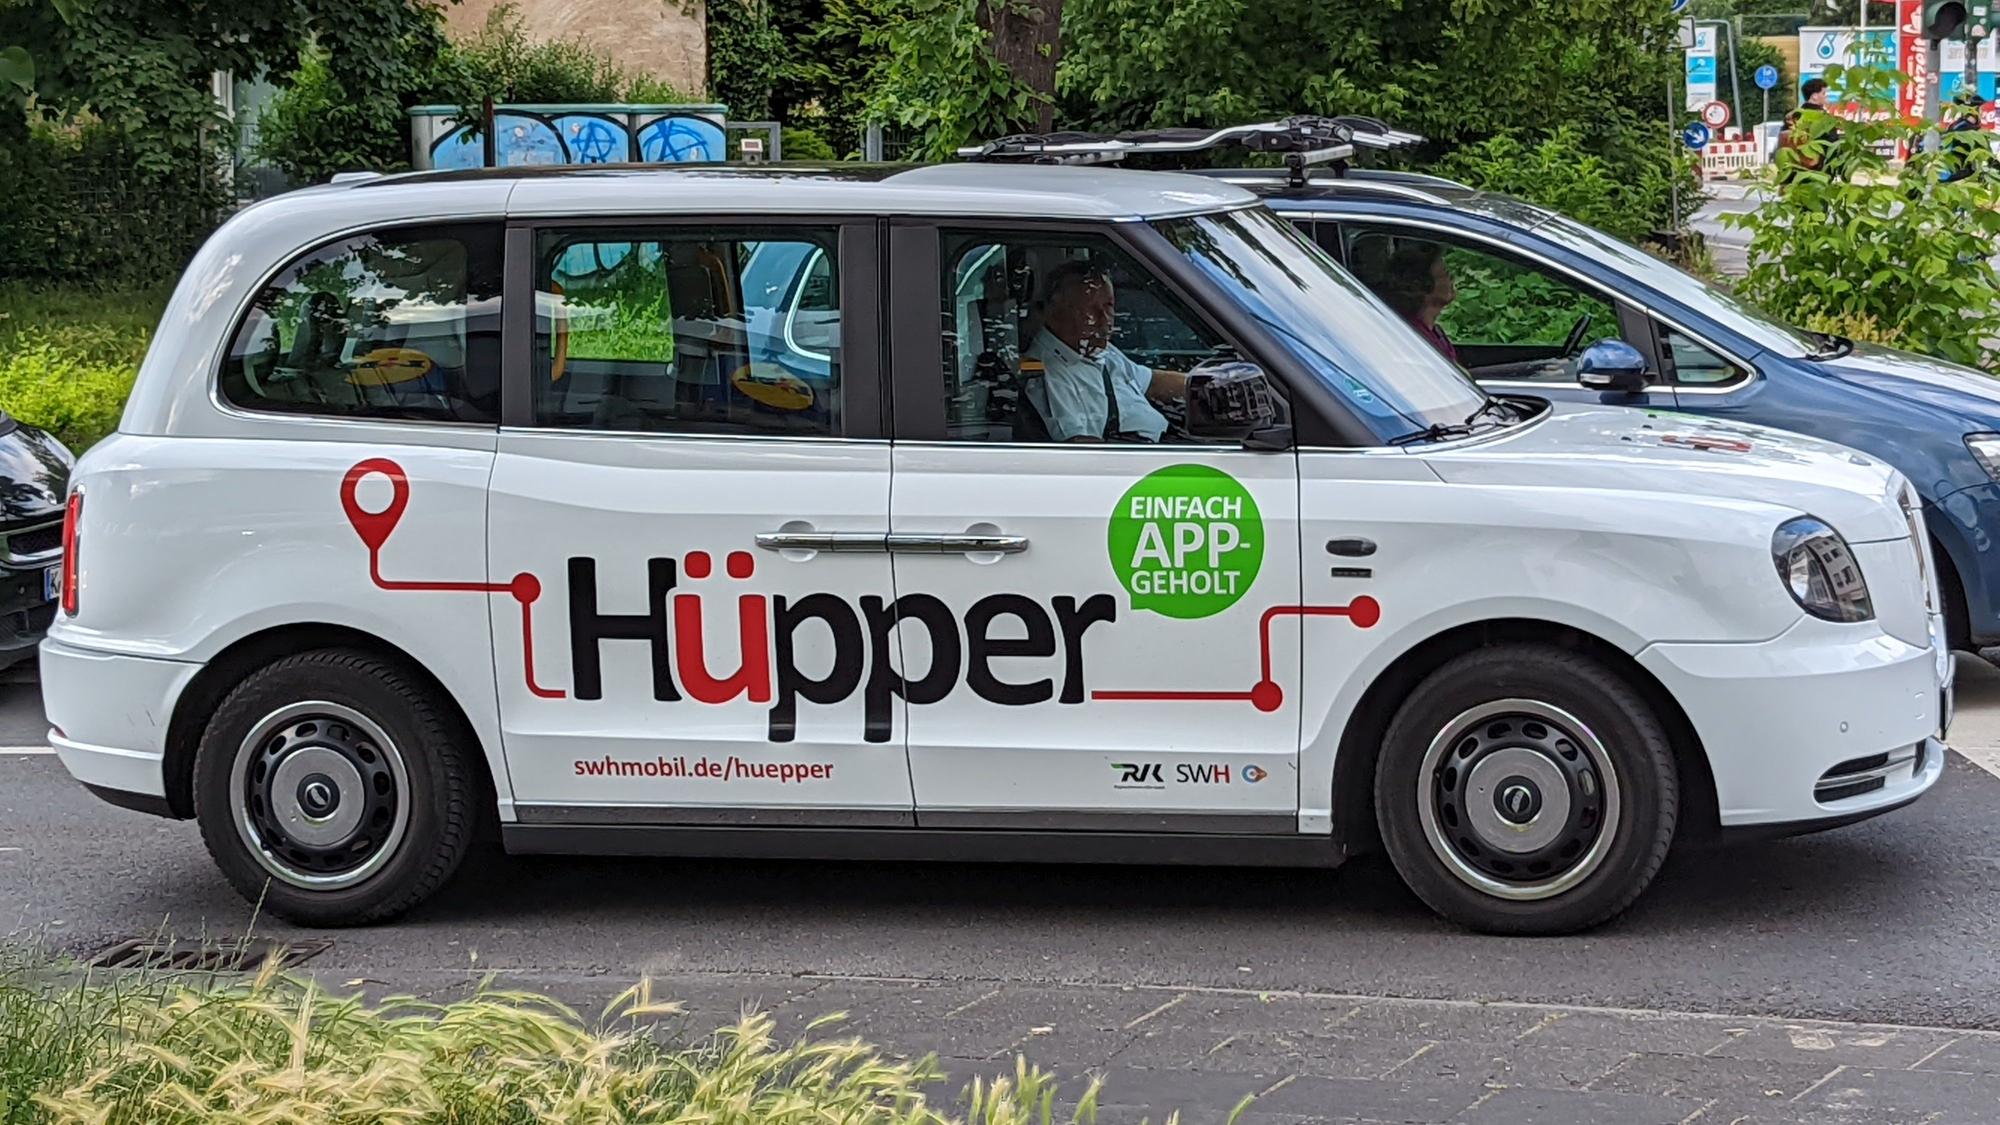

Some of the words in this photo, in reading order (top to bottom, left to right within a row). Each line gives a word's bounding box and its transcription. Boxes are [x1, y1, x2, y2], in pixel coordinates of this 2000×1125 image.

[1130, 496, 1242, 519] EINFACH
[1131, 522, 1251, 568] APP-
[1131, 571, 1241, 594] GEHOLT
[567, 550, 1117, 743] Hüpper
[574, 756, 834, 783] swhmobil.de/huepper
[1176, 763, 1230, 783] SWH
